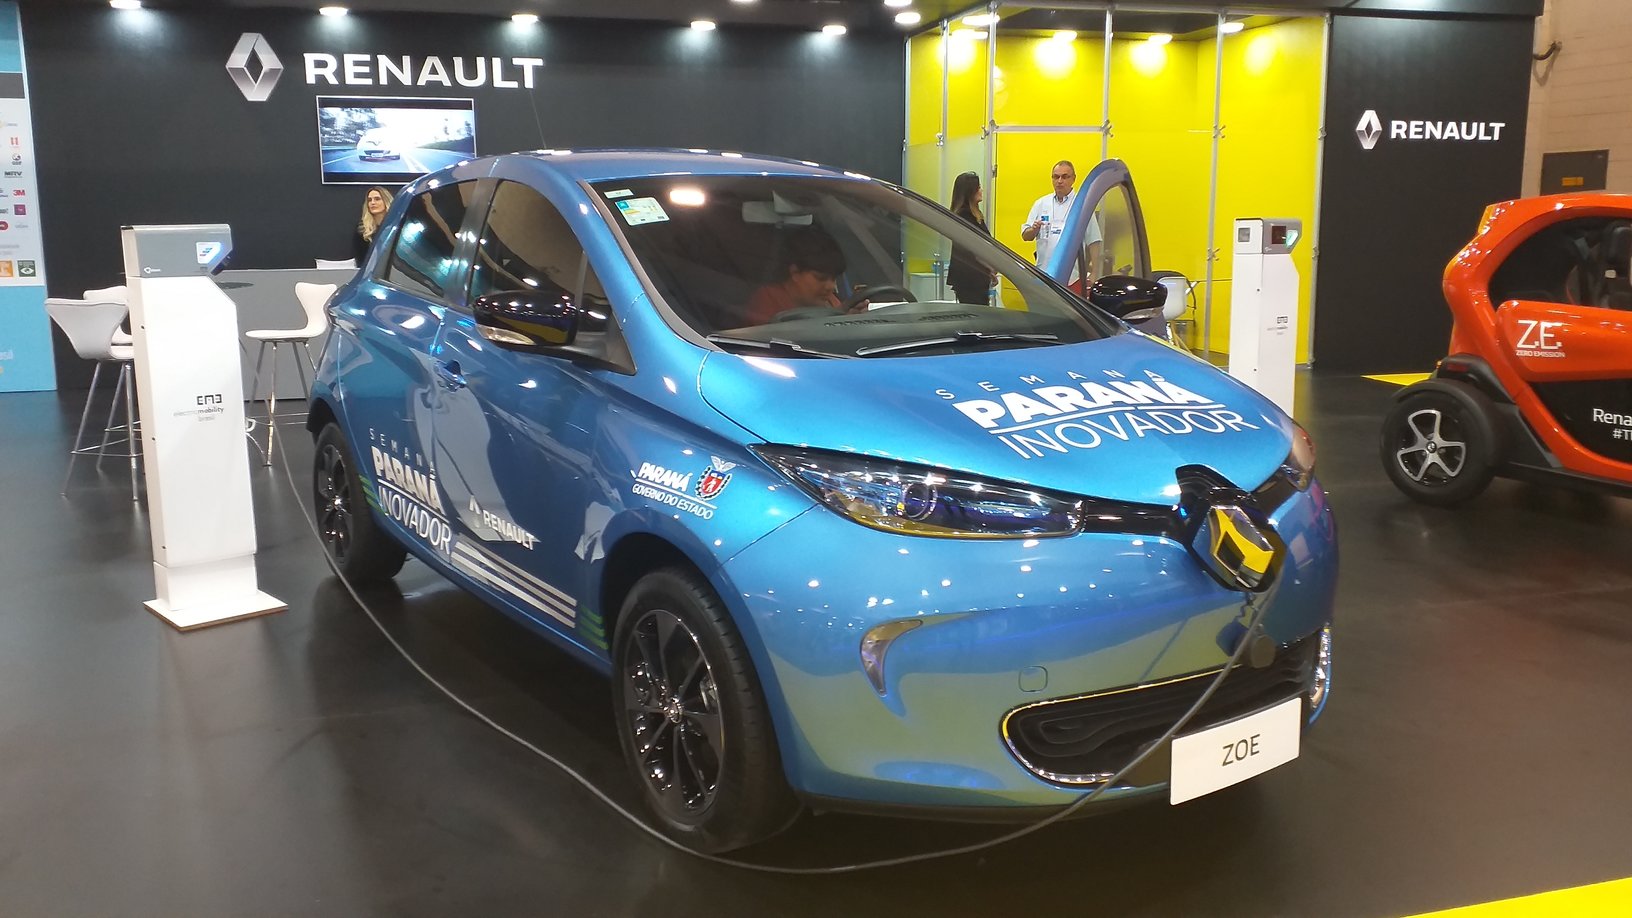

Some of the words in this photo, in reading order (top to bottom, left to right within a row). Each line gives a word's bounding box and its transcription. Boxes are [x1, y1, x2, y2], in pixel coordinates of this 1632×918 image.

[303, 52, 544, 89] RENAULT
[1390, 120, 1505, 141] RENAULT
[952, 376, 1213, 428] PARANÁ
[997, 411, 1260, 459] INOVADOR
[371, 445, 446, 516] PARANÁ
[637, 462, 694, 492] PARANÁ
[378, 485, 451, 554] INOVADOR
[632, 483, 665, 502] GOVERNO
[663, 494, 678, 506] DO
[676, 499, 714, 520] ESTADO
[483, 509, 535, 551] RENAULT
[1222, 734, 1260, 766] ZOE
